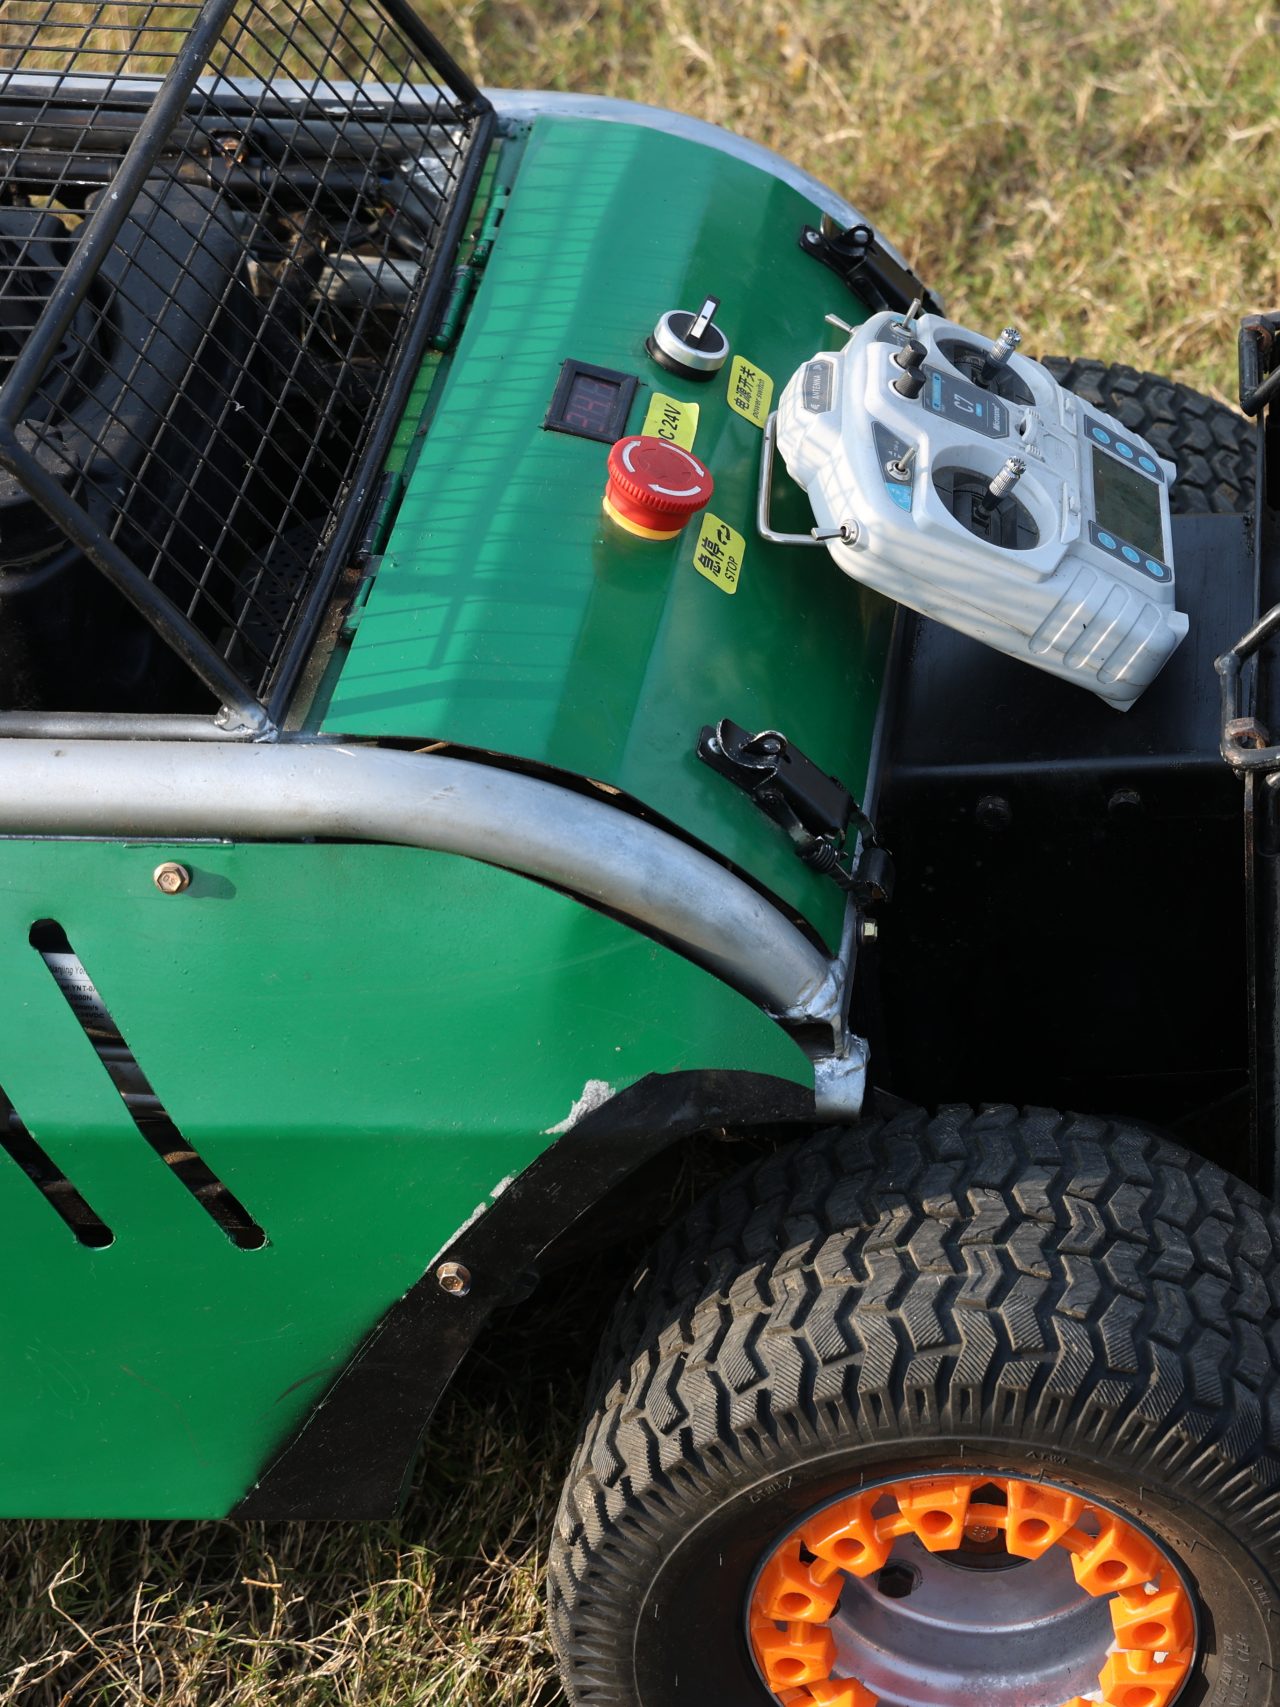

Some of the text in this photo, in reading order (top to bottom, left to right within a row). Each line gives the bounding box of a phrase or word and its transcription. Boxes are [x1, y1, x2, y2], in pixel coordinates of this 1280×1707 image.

[734, 365, 756, 411] 电源开关
[752, 377, 765, 420] power switch
[812, 374, 821, 400] ANTENNA
[661, 403, 682, 431] 24V
[953, 393, 974, 413] C7
[697, 536, 724, 578] 急停
[724, 555, 738, 583] STOP
